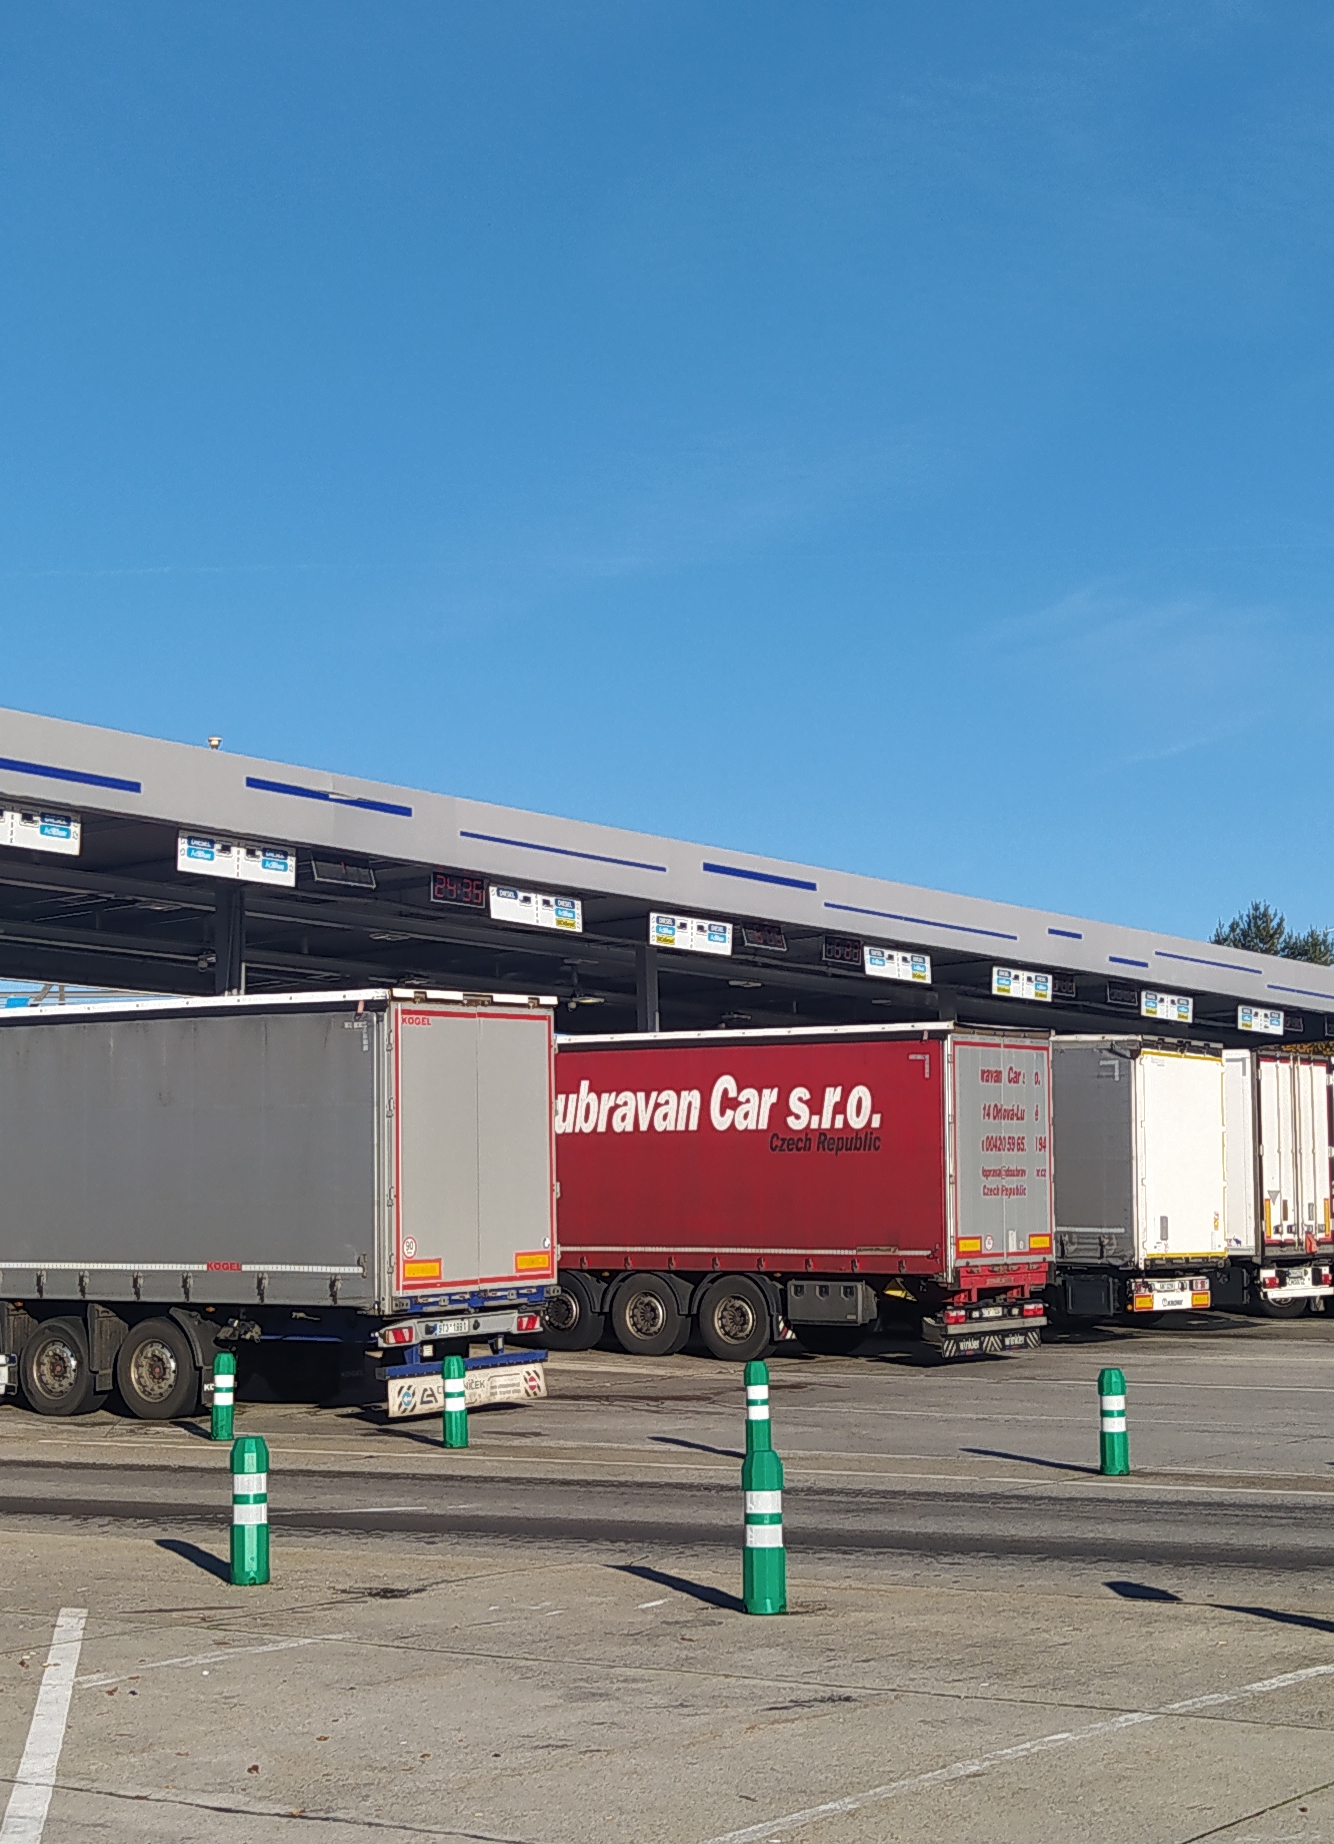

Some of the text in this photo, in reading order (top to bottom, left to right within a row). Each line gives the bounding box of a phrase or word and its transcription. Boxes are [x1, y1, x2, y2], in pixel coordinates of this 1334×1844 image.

[1008, 1066, 1021, 1084] Car
[555, 1075, 881, 1134] ubravan Car s.r.o.
[769, 1131, 881, 1155] Czech Republic
[405, 1240, 414, 1251] 90
